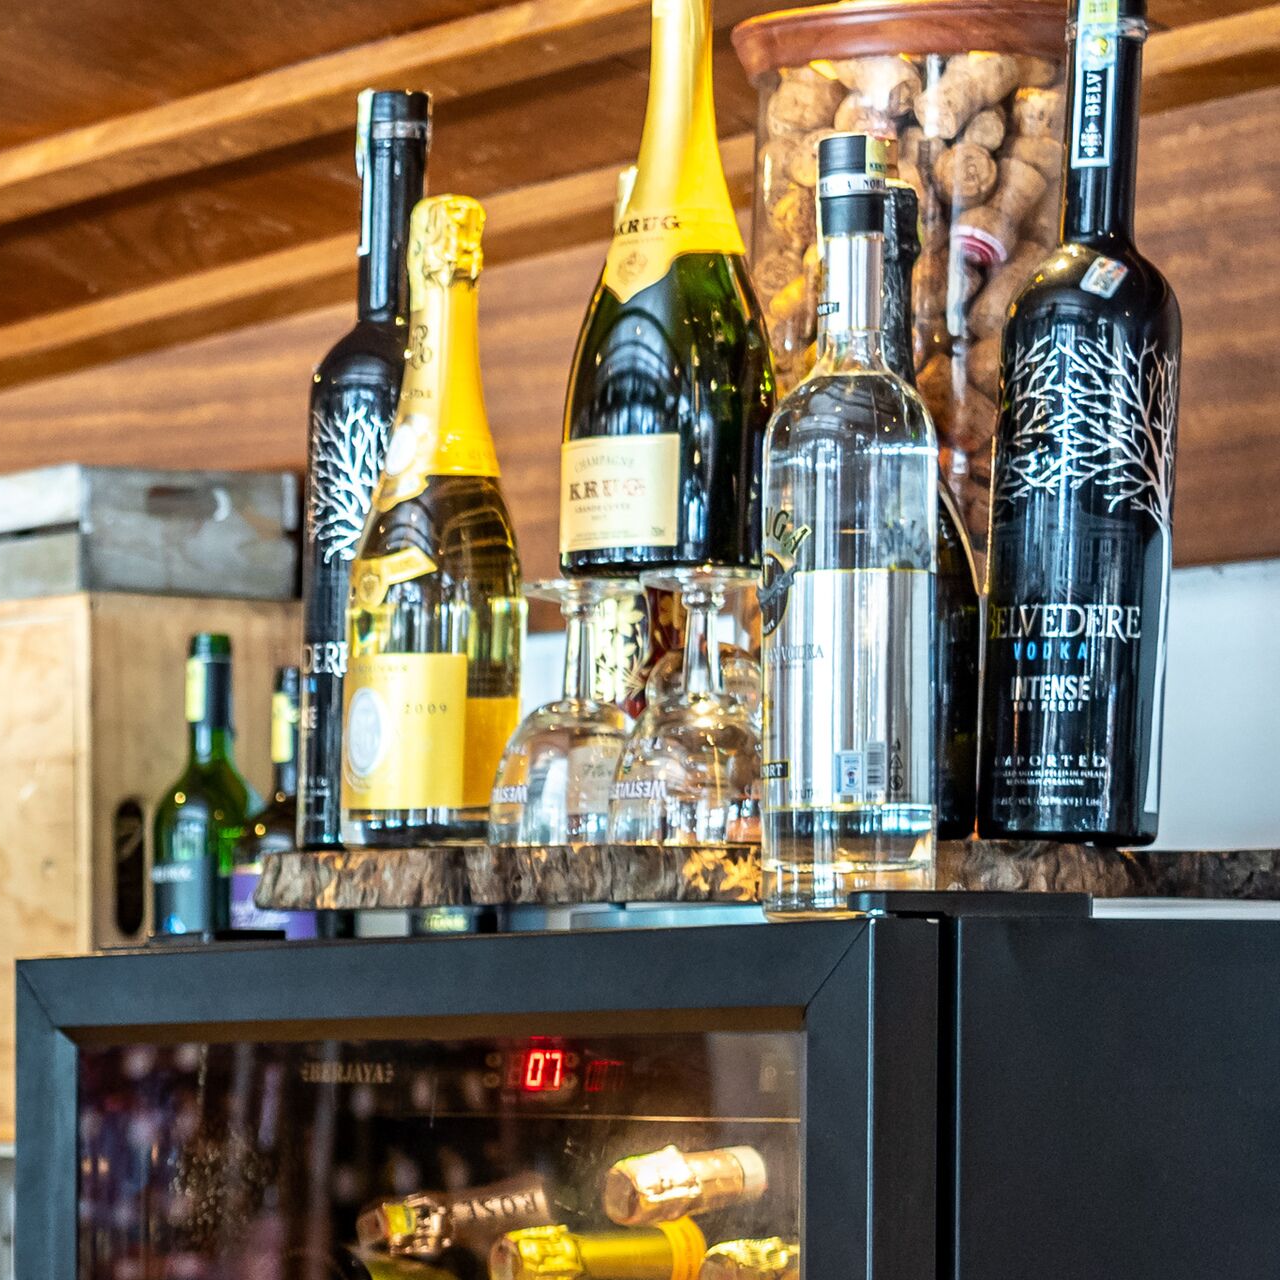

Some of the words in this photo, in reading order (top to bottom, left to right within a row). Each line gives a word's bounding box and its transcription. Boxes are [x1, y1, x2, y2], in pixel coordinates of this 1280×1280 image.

[569, 478, 646, 501] KRUG
[990, 603, 1142, 643] BELVEDERE
[1013, 642, 1088, 661] VODKA
[1011, 674, 1091, 701] INTENSE
[404, 703, 448, 715] 2009
